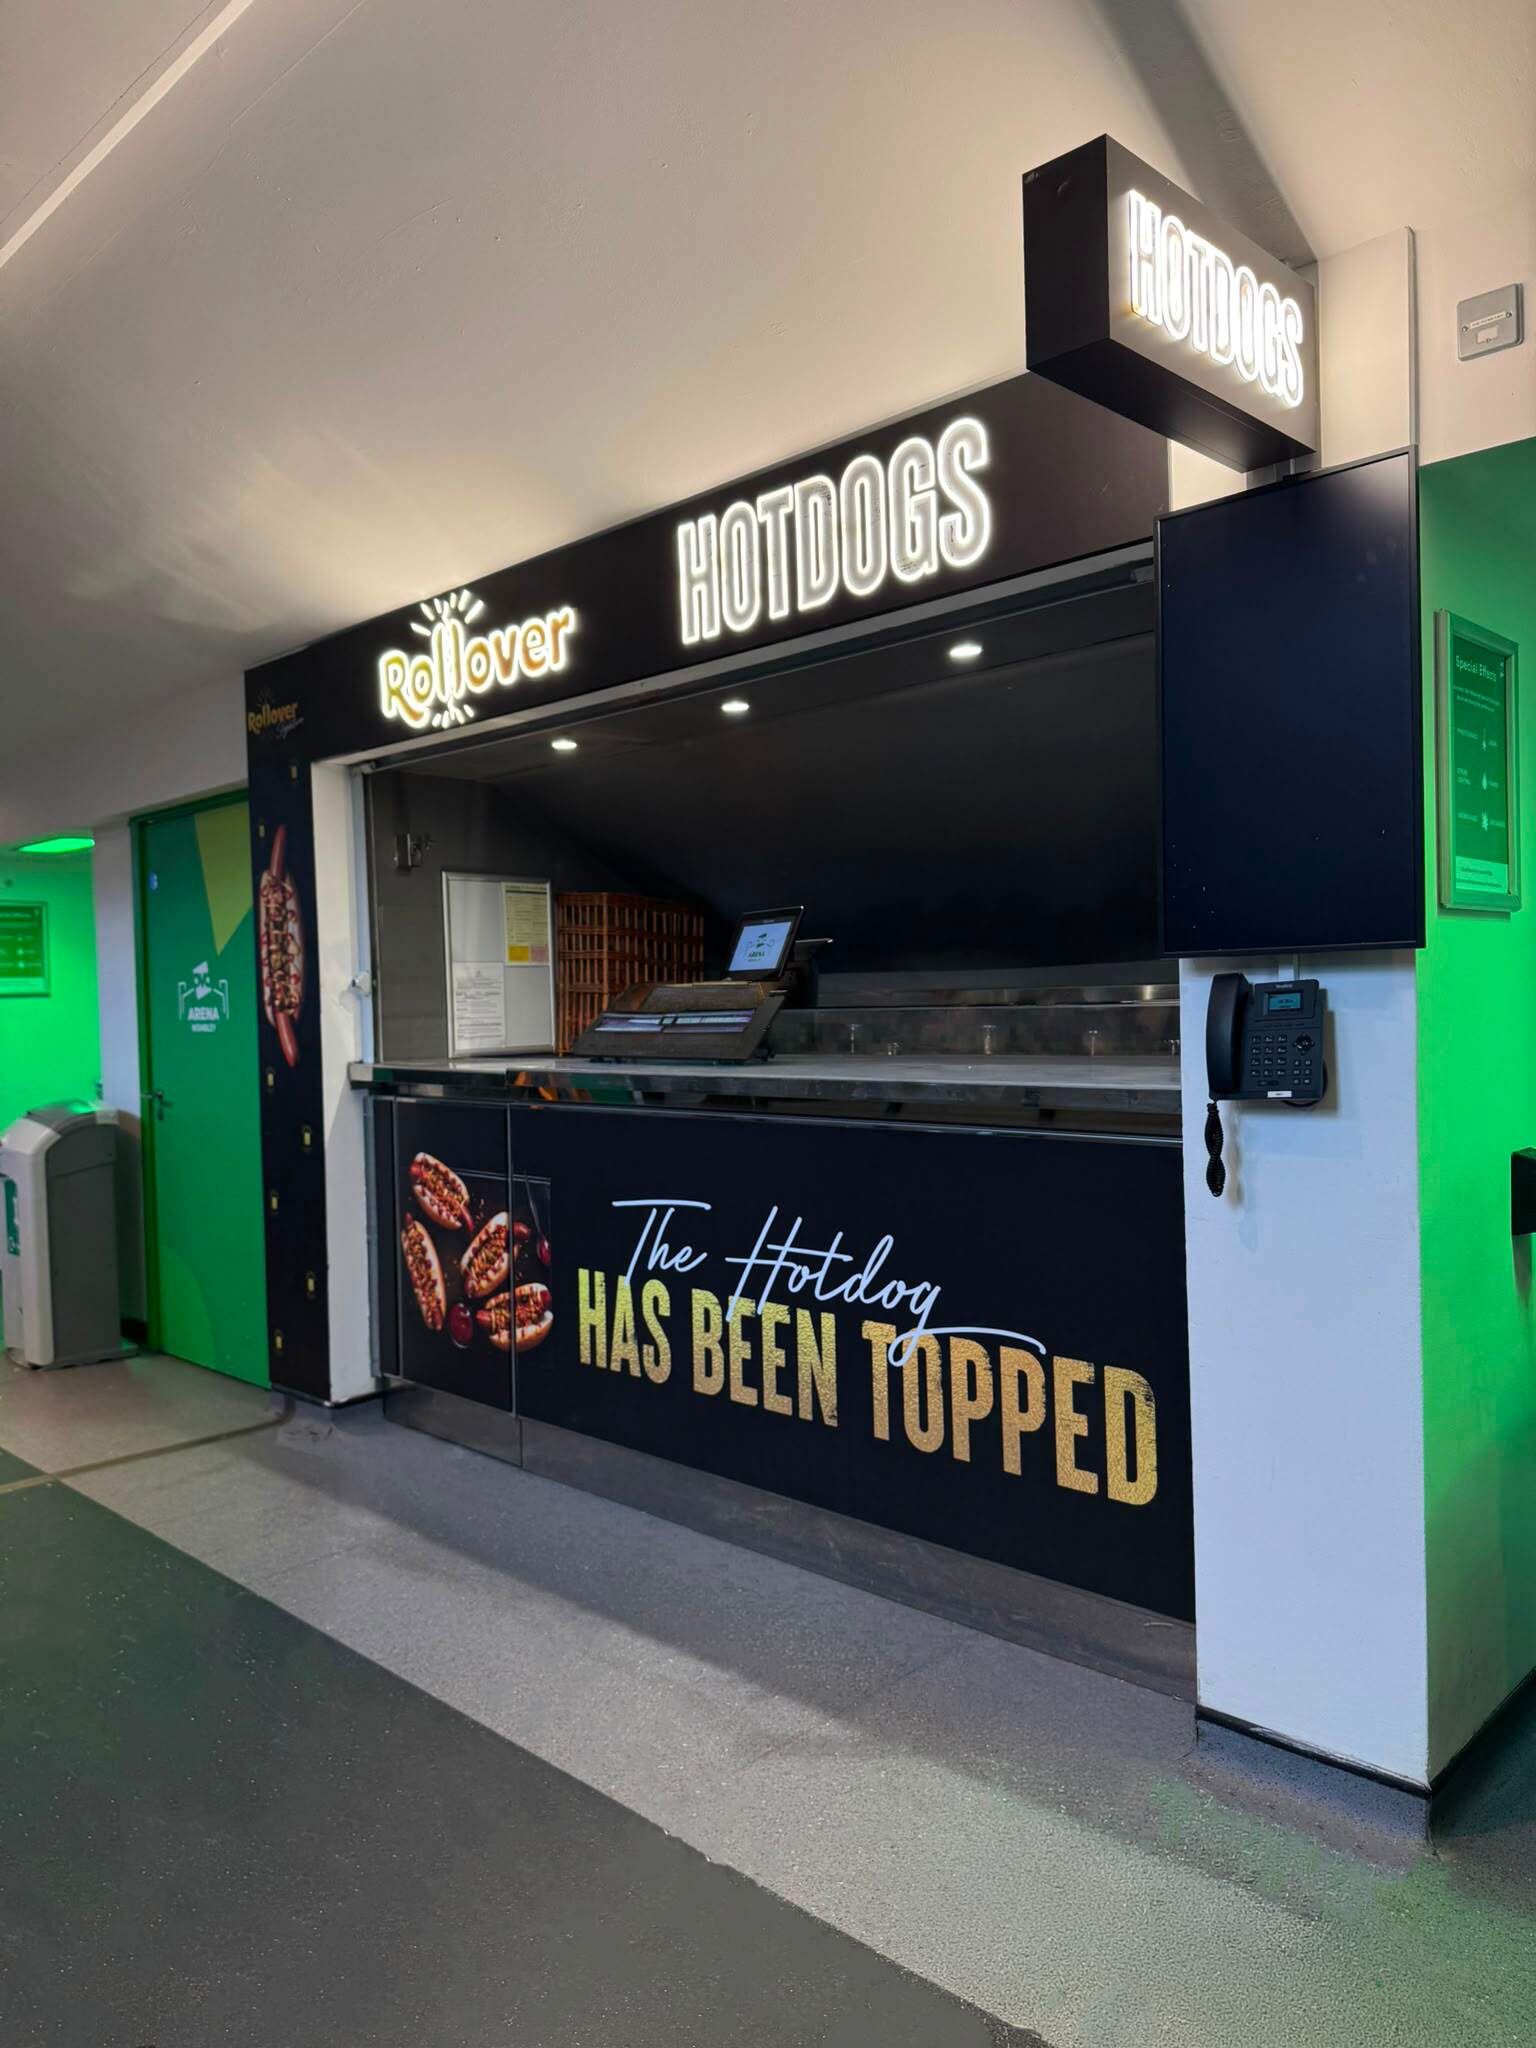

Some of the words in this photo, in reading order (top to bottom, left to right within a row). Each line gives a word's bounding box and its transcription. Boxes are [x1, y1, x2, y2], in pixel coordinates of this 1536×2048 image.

[1128, 188, 1304, 408] HOTDOGS
[676, 416, 991, 647] HOTDOGS
[379, 606, 577, 729] Rollover
[1455, 654, 1478, 674] Special
[1479, 663, 1497, 683] Effects
[187, 1006, 220, 1021] ARENA
[612, 1199, 711, 1287] The
[725, 1205, 1046, 1367] Hotdog
[578, 1267, 671, 1384] HAS
[691, 1287, 839, 1428] BEEN
[862, 1319, 1158, 1506] TOPPED
